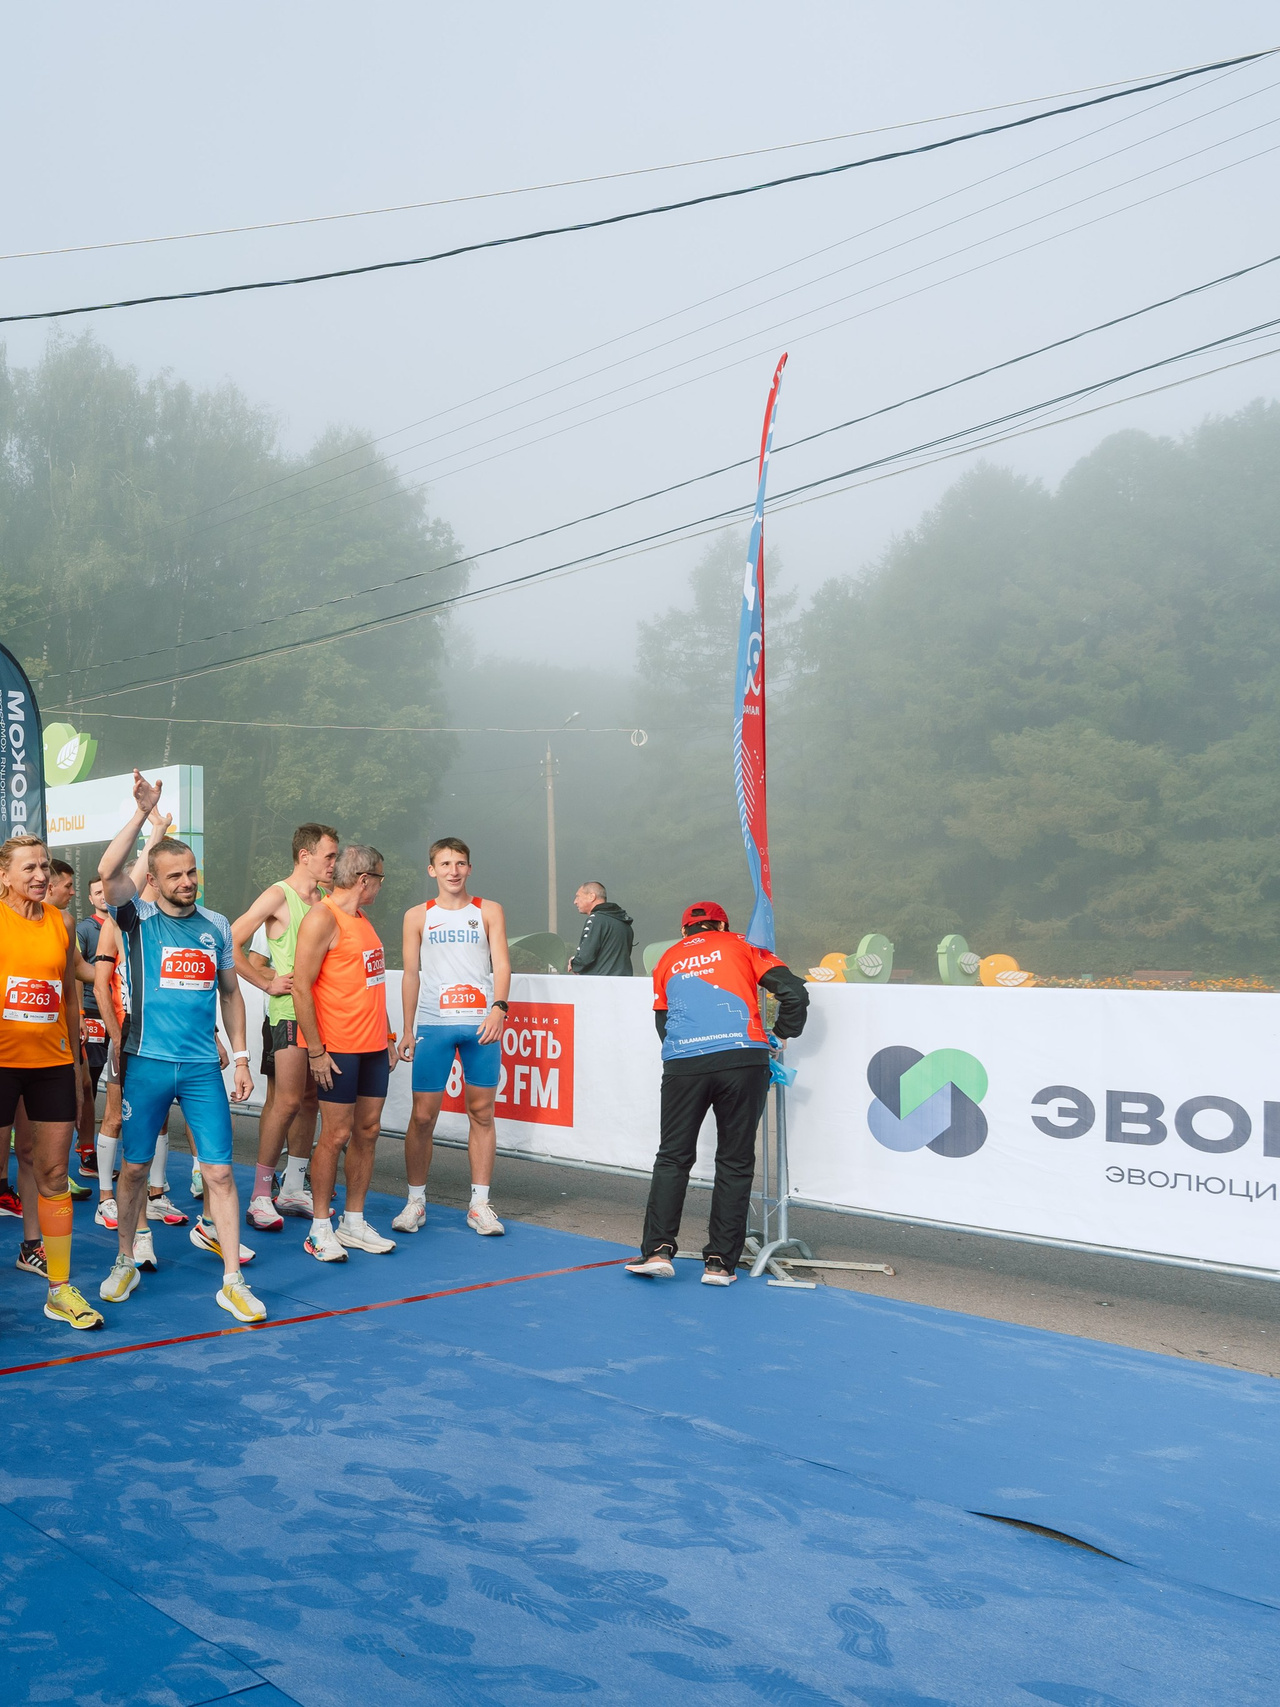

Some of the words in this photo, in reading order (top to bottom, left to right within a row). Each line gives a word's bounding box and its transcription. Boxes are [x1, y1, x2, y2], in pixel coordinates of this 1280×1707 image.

[46, 814, 85, 834] АЛЫШ
[428, 930, 480, 945] RUSSIA
[174, 960, 206, 974] 2003
[671, 949, 722, 974] СУДЬЯ
[681, 967, 715, 980] referee
[20, 991, 51, 1006] 2263
[451, 993, 476, 1004] 2319
[504, 1015, 559, 1025] ТАНЦИЯ
[501, 1028, 562, 1060] ОСТЬ
[678, 1031, 744, 1046] TULAMARATHON.ORG
[513, 1064, 559, 1110] FM
